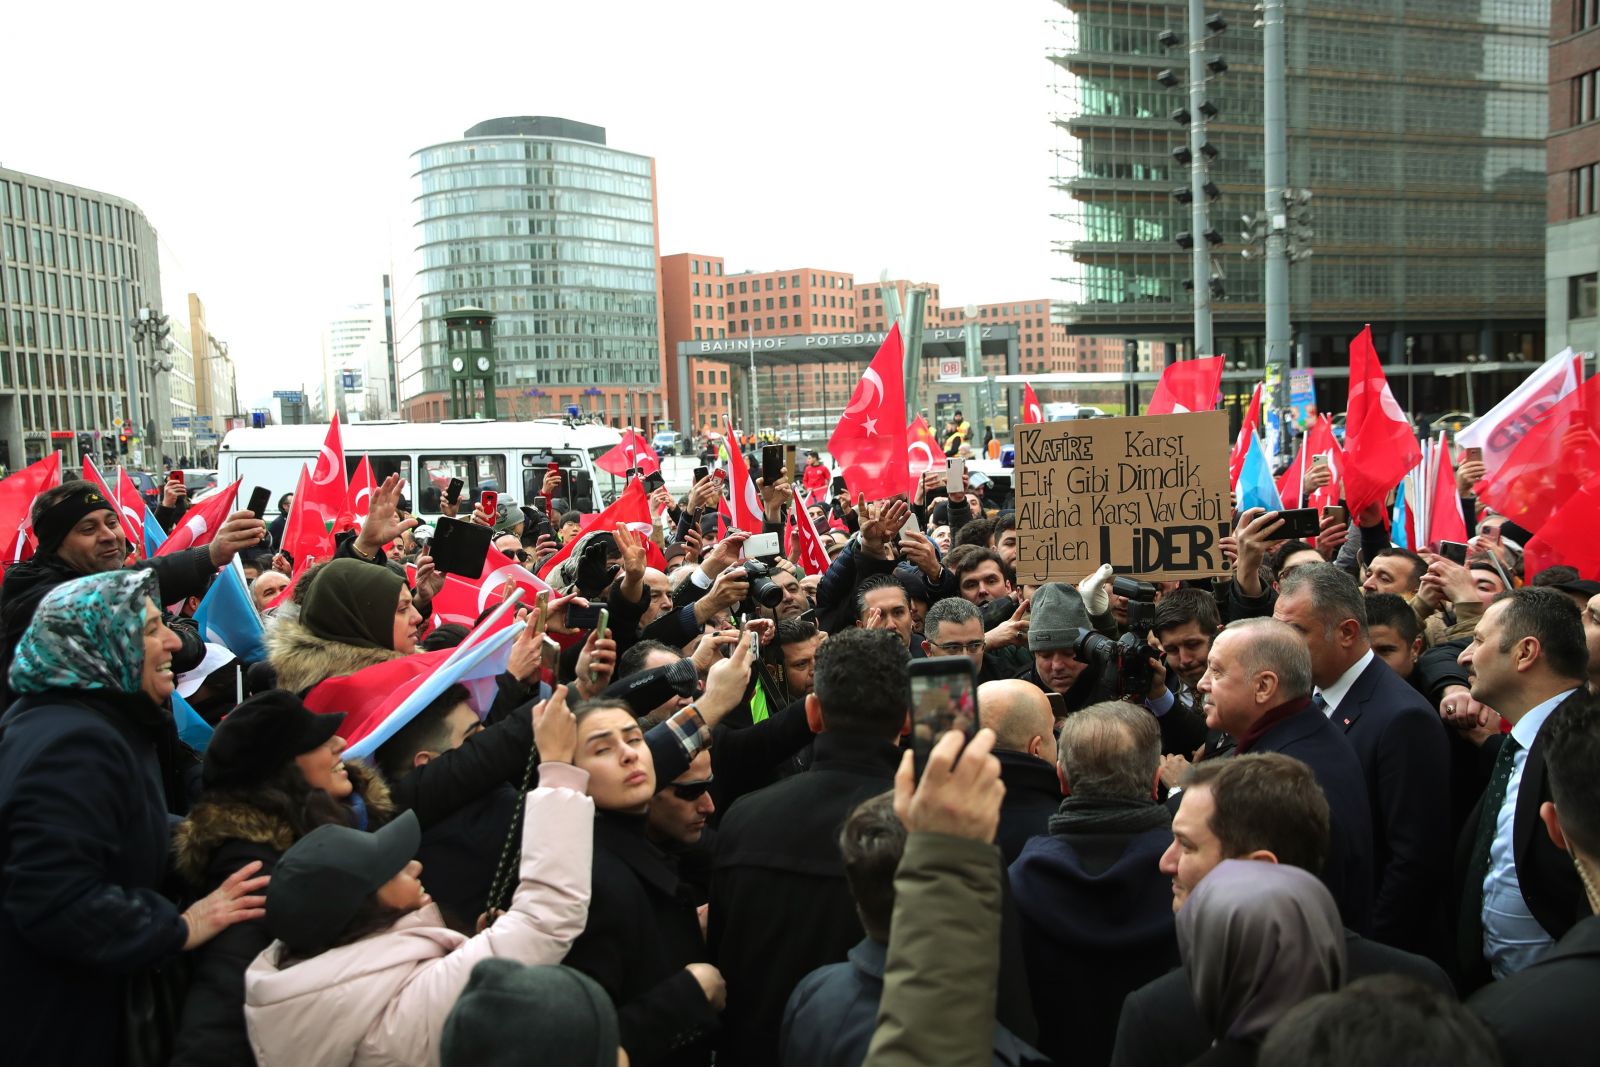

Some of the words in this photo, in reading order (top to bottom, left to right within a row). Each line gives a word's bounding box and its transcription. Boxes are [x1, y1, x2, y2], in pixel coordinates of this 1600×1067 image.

[701, 338, 787, 352] BAHNHOF
[935, 327, 992, 340] PLAZ
[943, 363, 957, 373] DB
[1020, 468, 1055, 503] Elif
[1067, 466, 1109, 495] Gibi
[1117, 456, 1201, 494] Dimdik
[1016, 497, 1082, 530] Allah'a
[1146, 493, 1176, 522] Vav
[1180, 488, 1222, 521] Gibi
[1018, 532, 1089, 581] Eğilen
